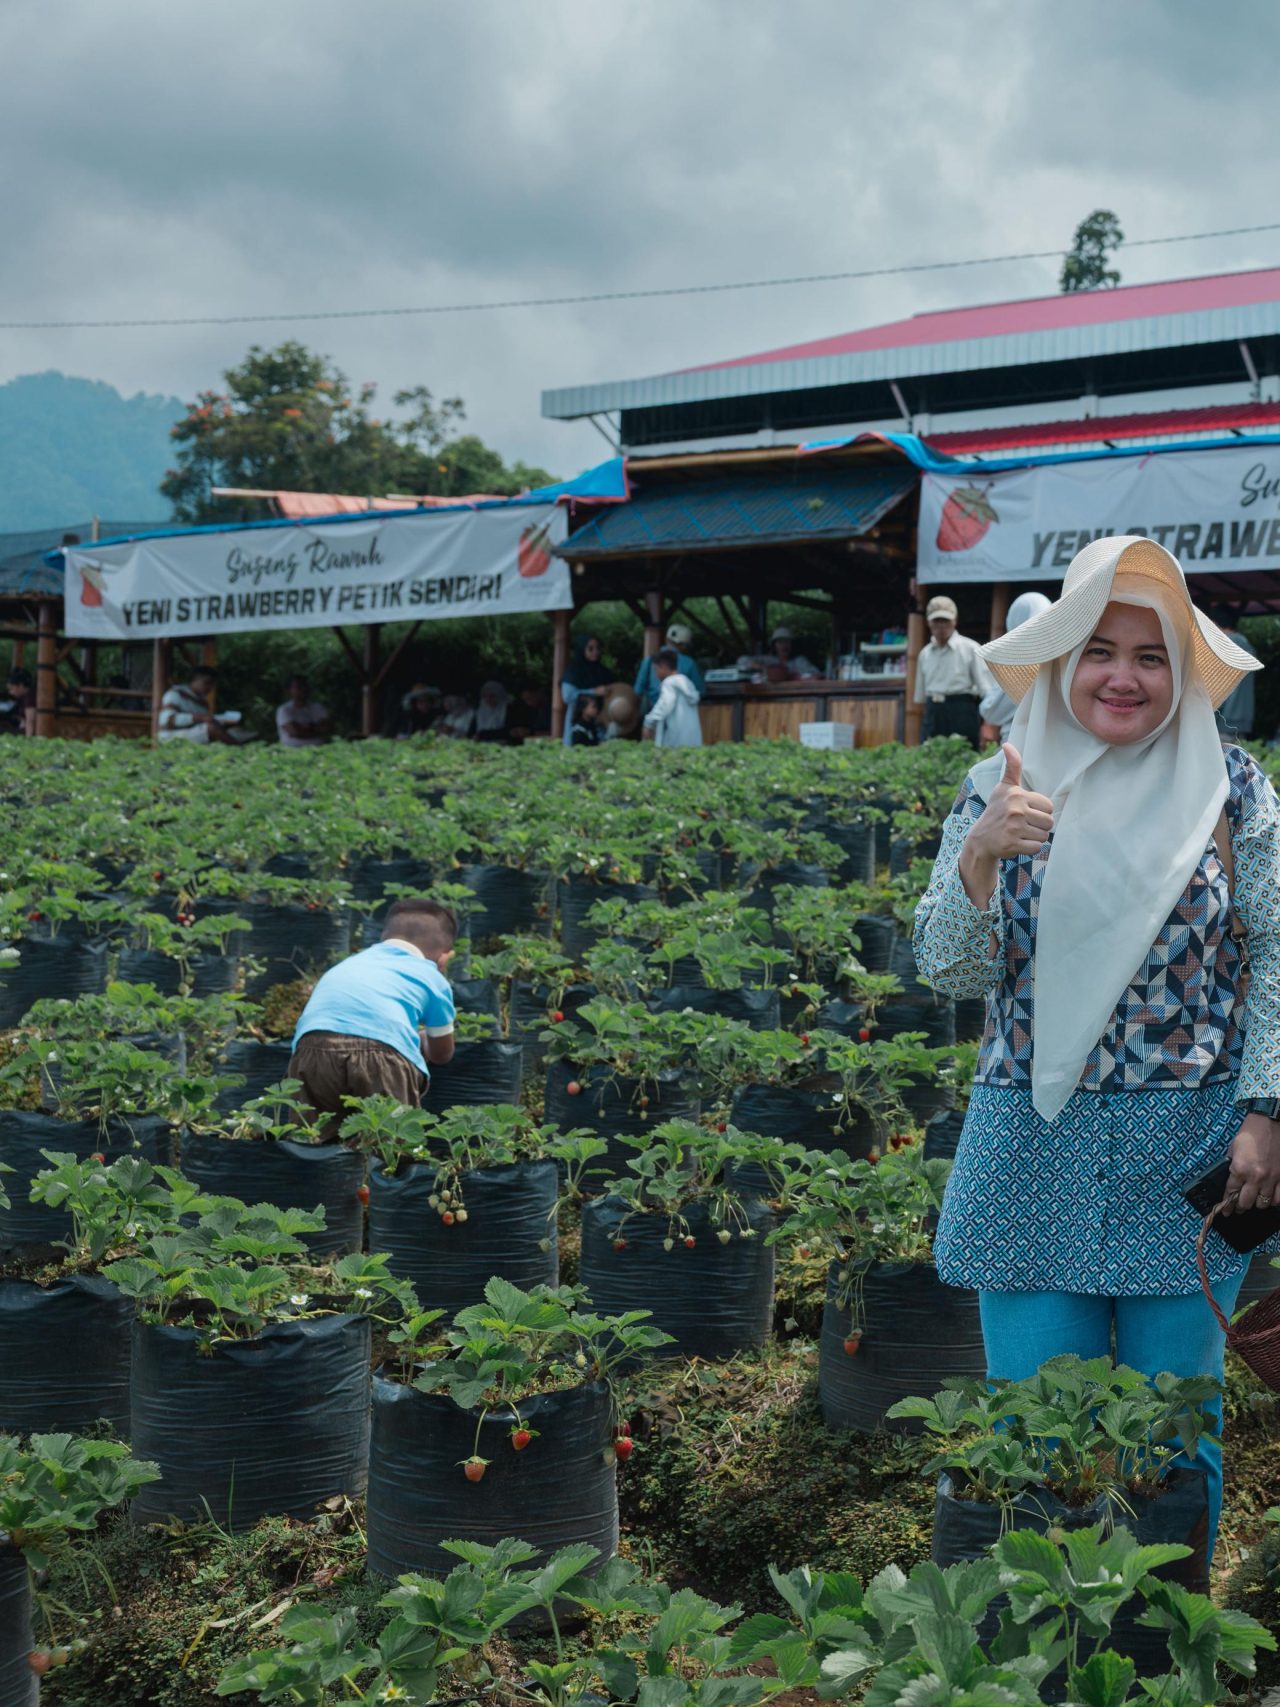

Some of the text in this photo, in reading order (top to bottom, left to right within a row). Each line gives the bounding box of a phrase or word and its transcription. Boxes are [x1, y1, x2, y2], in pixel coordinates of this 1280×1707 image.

[226, 536, 385, 586] Sugeng Rawuh
[122, 600, 171, 627] YENI
[176, 586, 334, 623] STRAWBERRY
[337, 580, 404, 613] PETIK
[408, 573, 502, 605] SENDIRI
